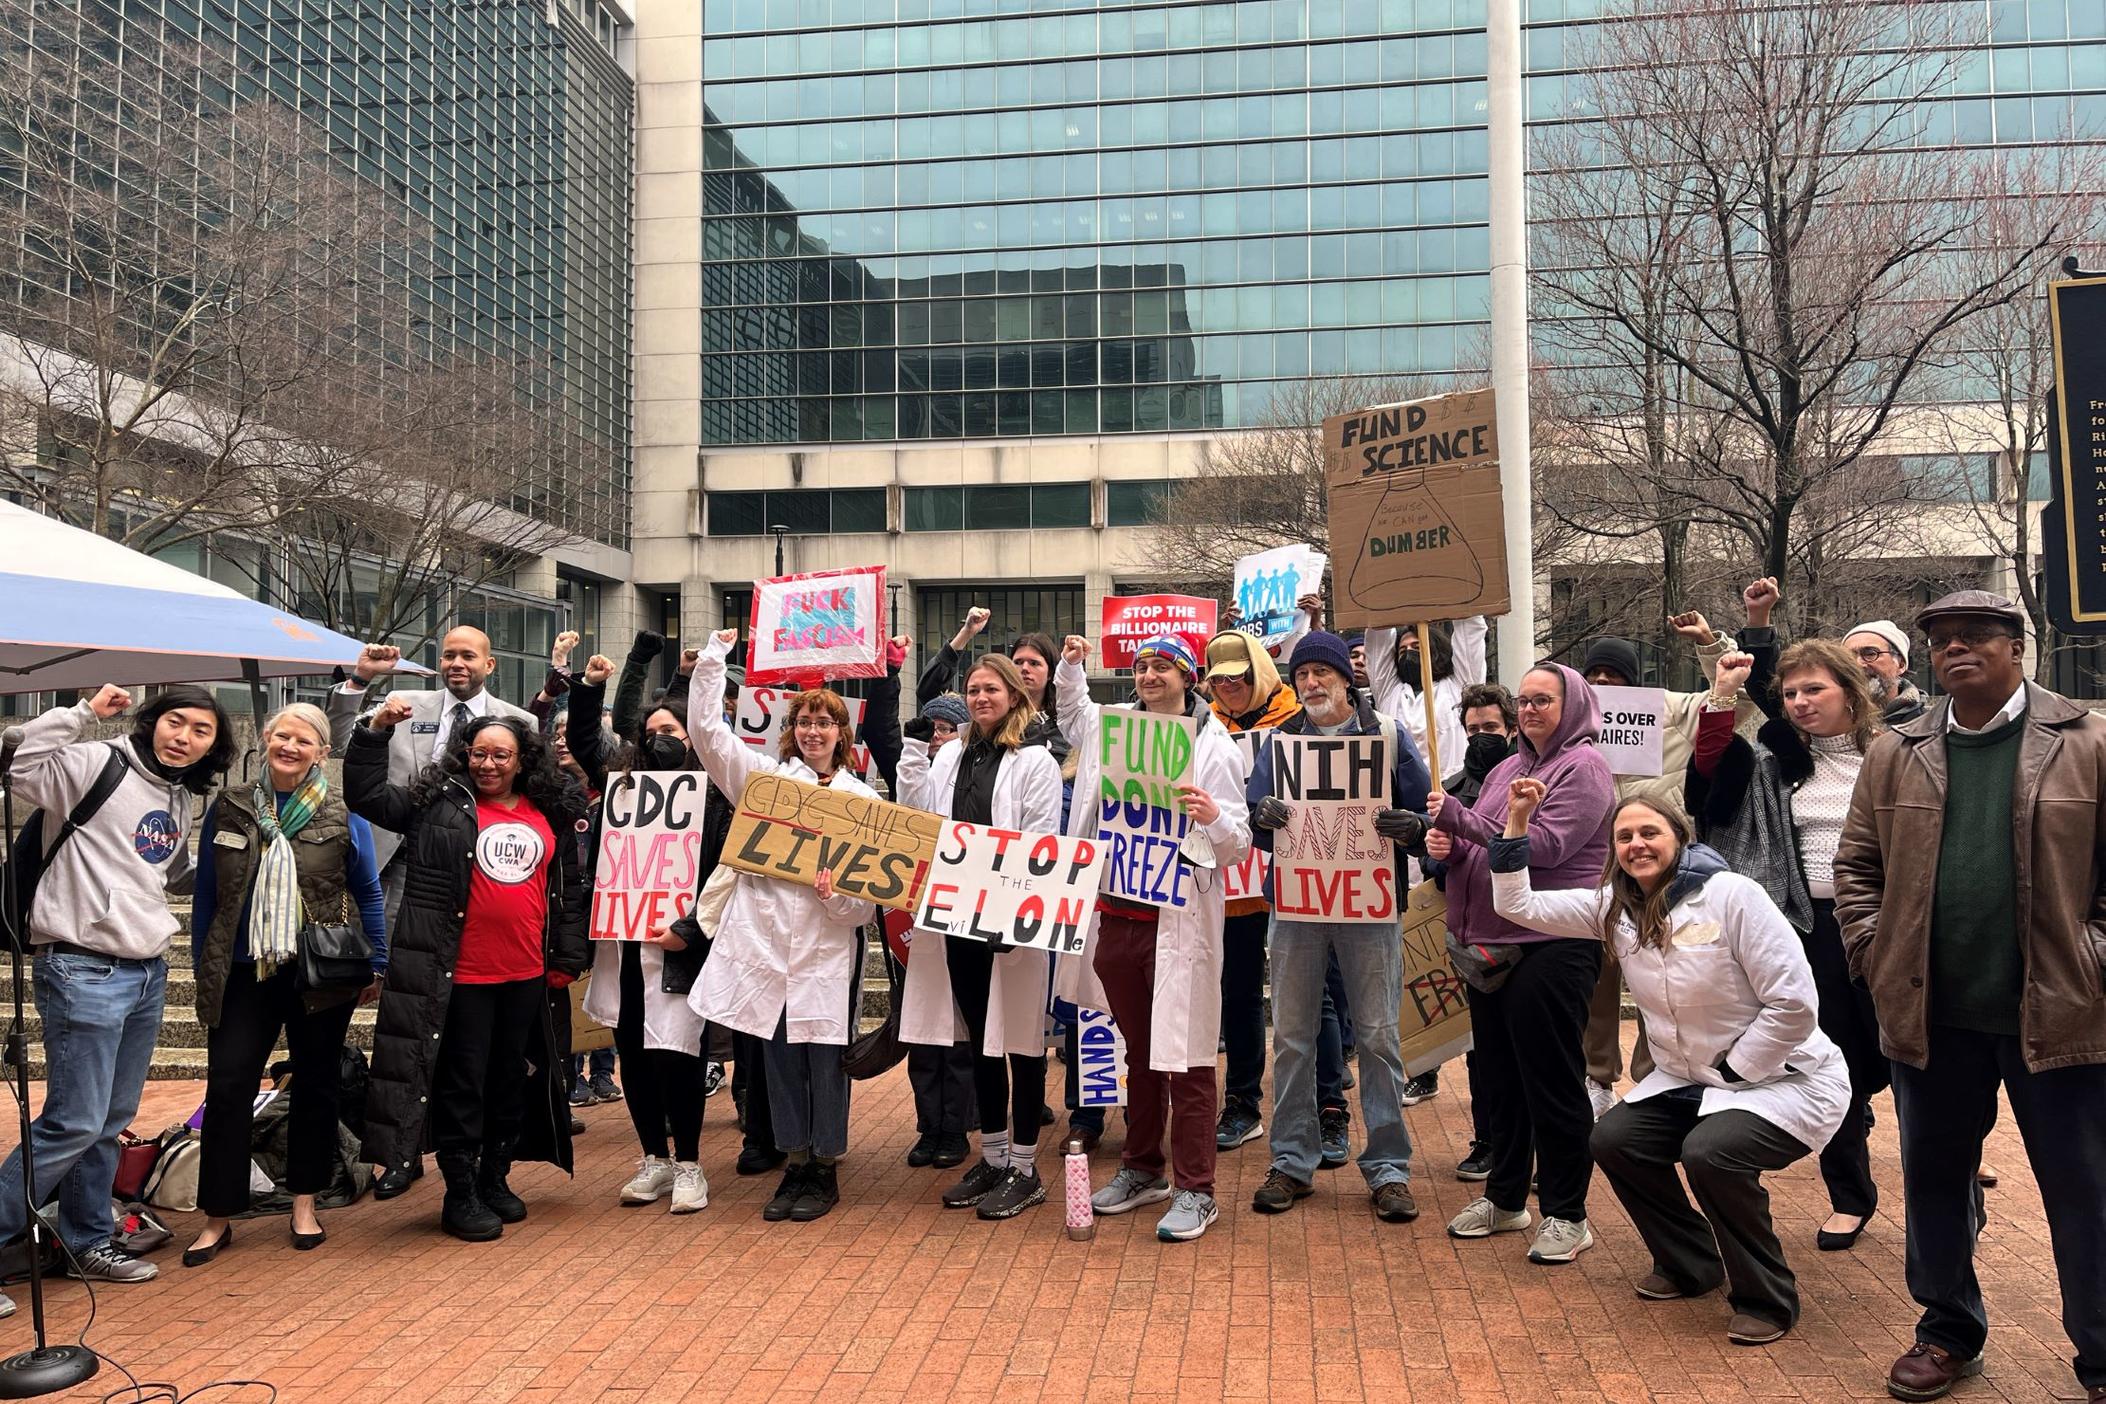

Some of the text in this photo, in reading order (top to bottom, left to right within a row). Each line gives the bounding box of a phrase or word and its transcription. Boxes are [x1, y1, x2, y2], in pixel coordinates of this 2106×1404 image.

[1341, 405, 1427, 448] FUND
[1362, 425, 1489, 476] SCIENCE
[1370, 525, 1451, 558] DUMBER
[783, 586, 849, 617] FUCK
[1122, 605, 1197, 619] STOP THE
[1270, 618, 1290, 630] WITH
[773, 623, 865, 653] FASCISM
[1110, 621, 1208, 635] BILLIONAIRE
[1597, 729, 1644, 746] AIRES!
[1616, 712, 1656, 726] OVER
[1102, 714, 1191, 781] FUND
[1273, 740, 1385, 801] NIH
[606, 774, 697, 830] CDC
[744, 775, 925, 854] CDC SAVES
[1101, 774, 1190, 839] DONT
[139, 823, 174, 851] NASA
[494, 841, 527, 860] UCW
[939, 822, 1096, 885] STOP
[1275, 805, 1392, 862] SAVES
[498, 857, 519, 866] CWA
[595, 830, 701, 890] SAVES
[738, 820, 930, 909] LIVES!
[1000, 875, 1033, 891] THE
[590, 891, 693, 940] LIVES
[1275, 866, 1393, 919] LIVES
[1080, 1009, 1118, 1106] HANDS
